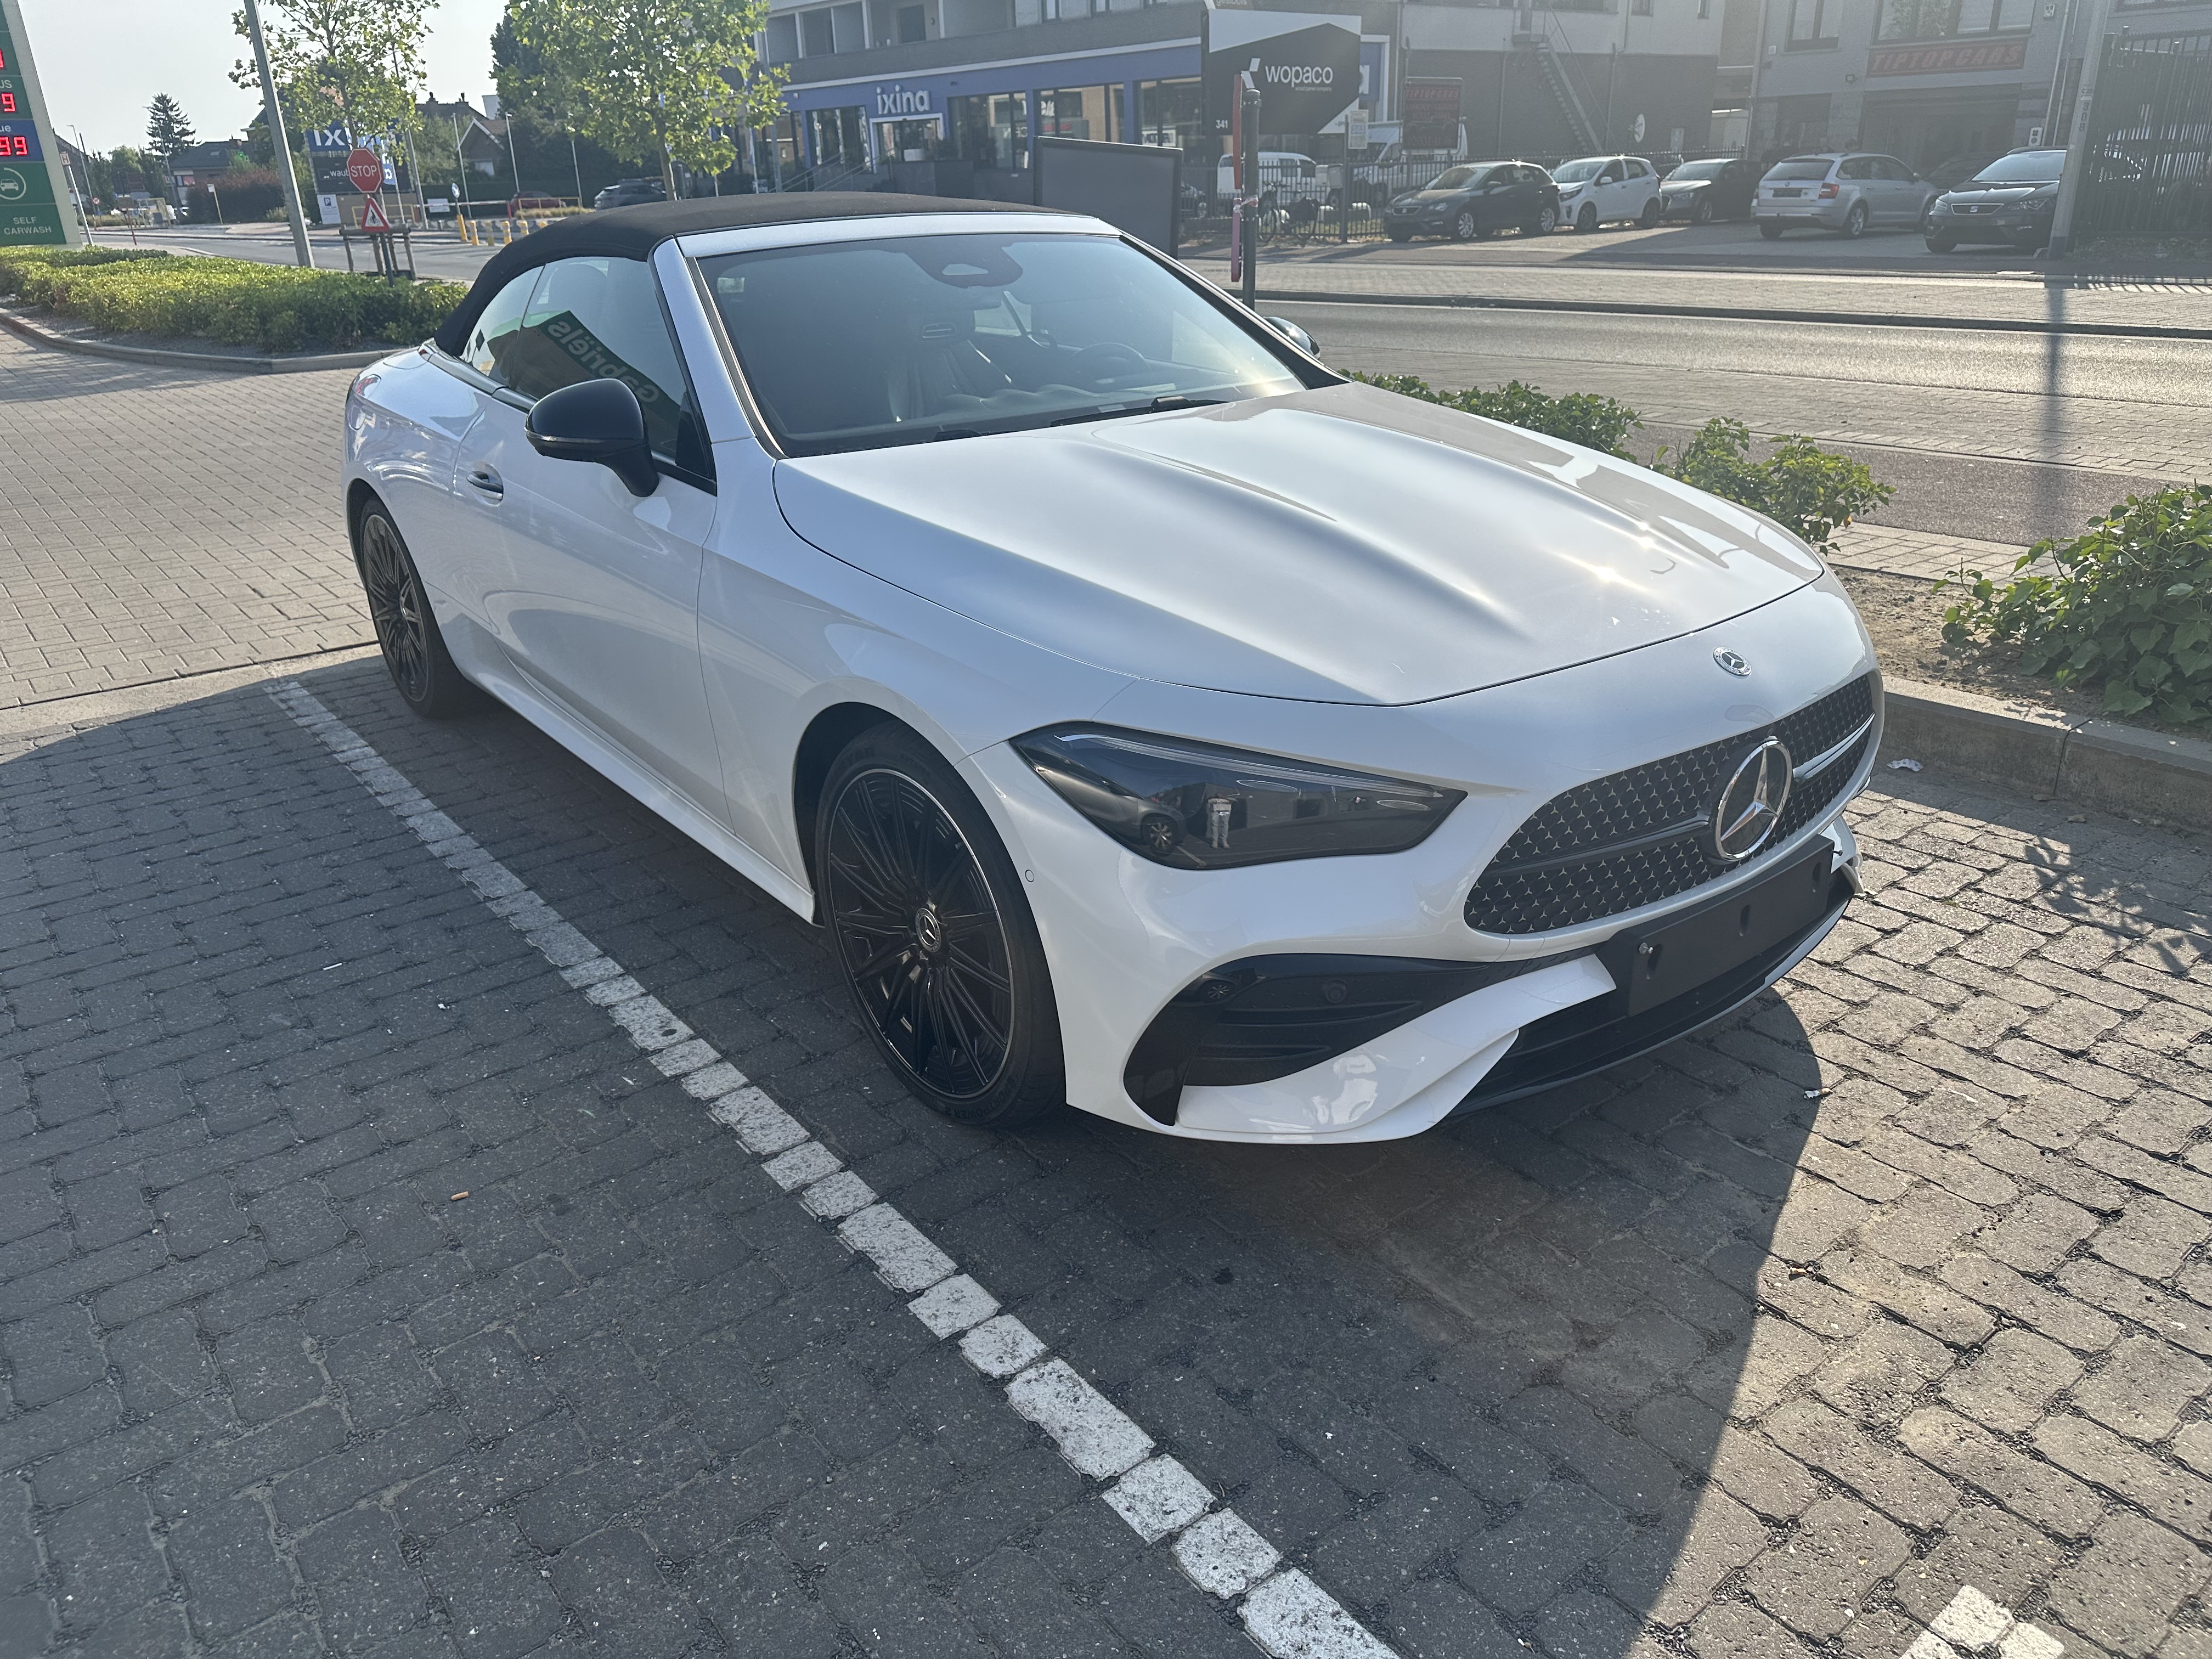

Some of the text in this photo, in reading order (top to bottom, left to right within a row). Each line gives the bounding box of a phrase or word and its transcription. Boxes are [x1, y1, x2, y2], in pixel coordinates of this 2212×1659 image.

[1265, 65, 1333, 88] wopaco
[1, 93, 15, 112] 9
[876, 84, 931, 115] ixina
[1215, 120, 1228, 129] 341
[0, 137, 27, 156] 99
[330, 169, 349, 177] waut
[351, 165, 377, 178] STOP
[13, 216, 37, 224] SELF
[4, 226, 52, 235] CARWASH
